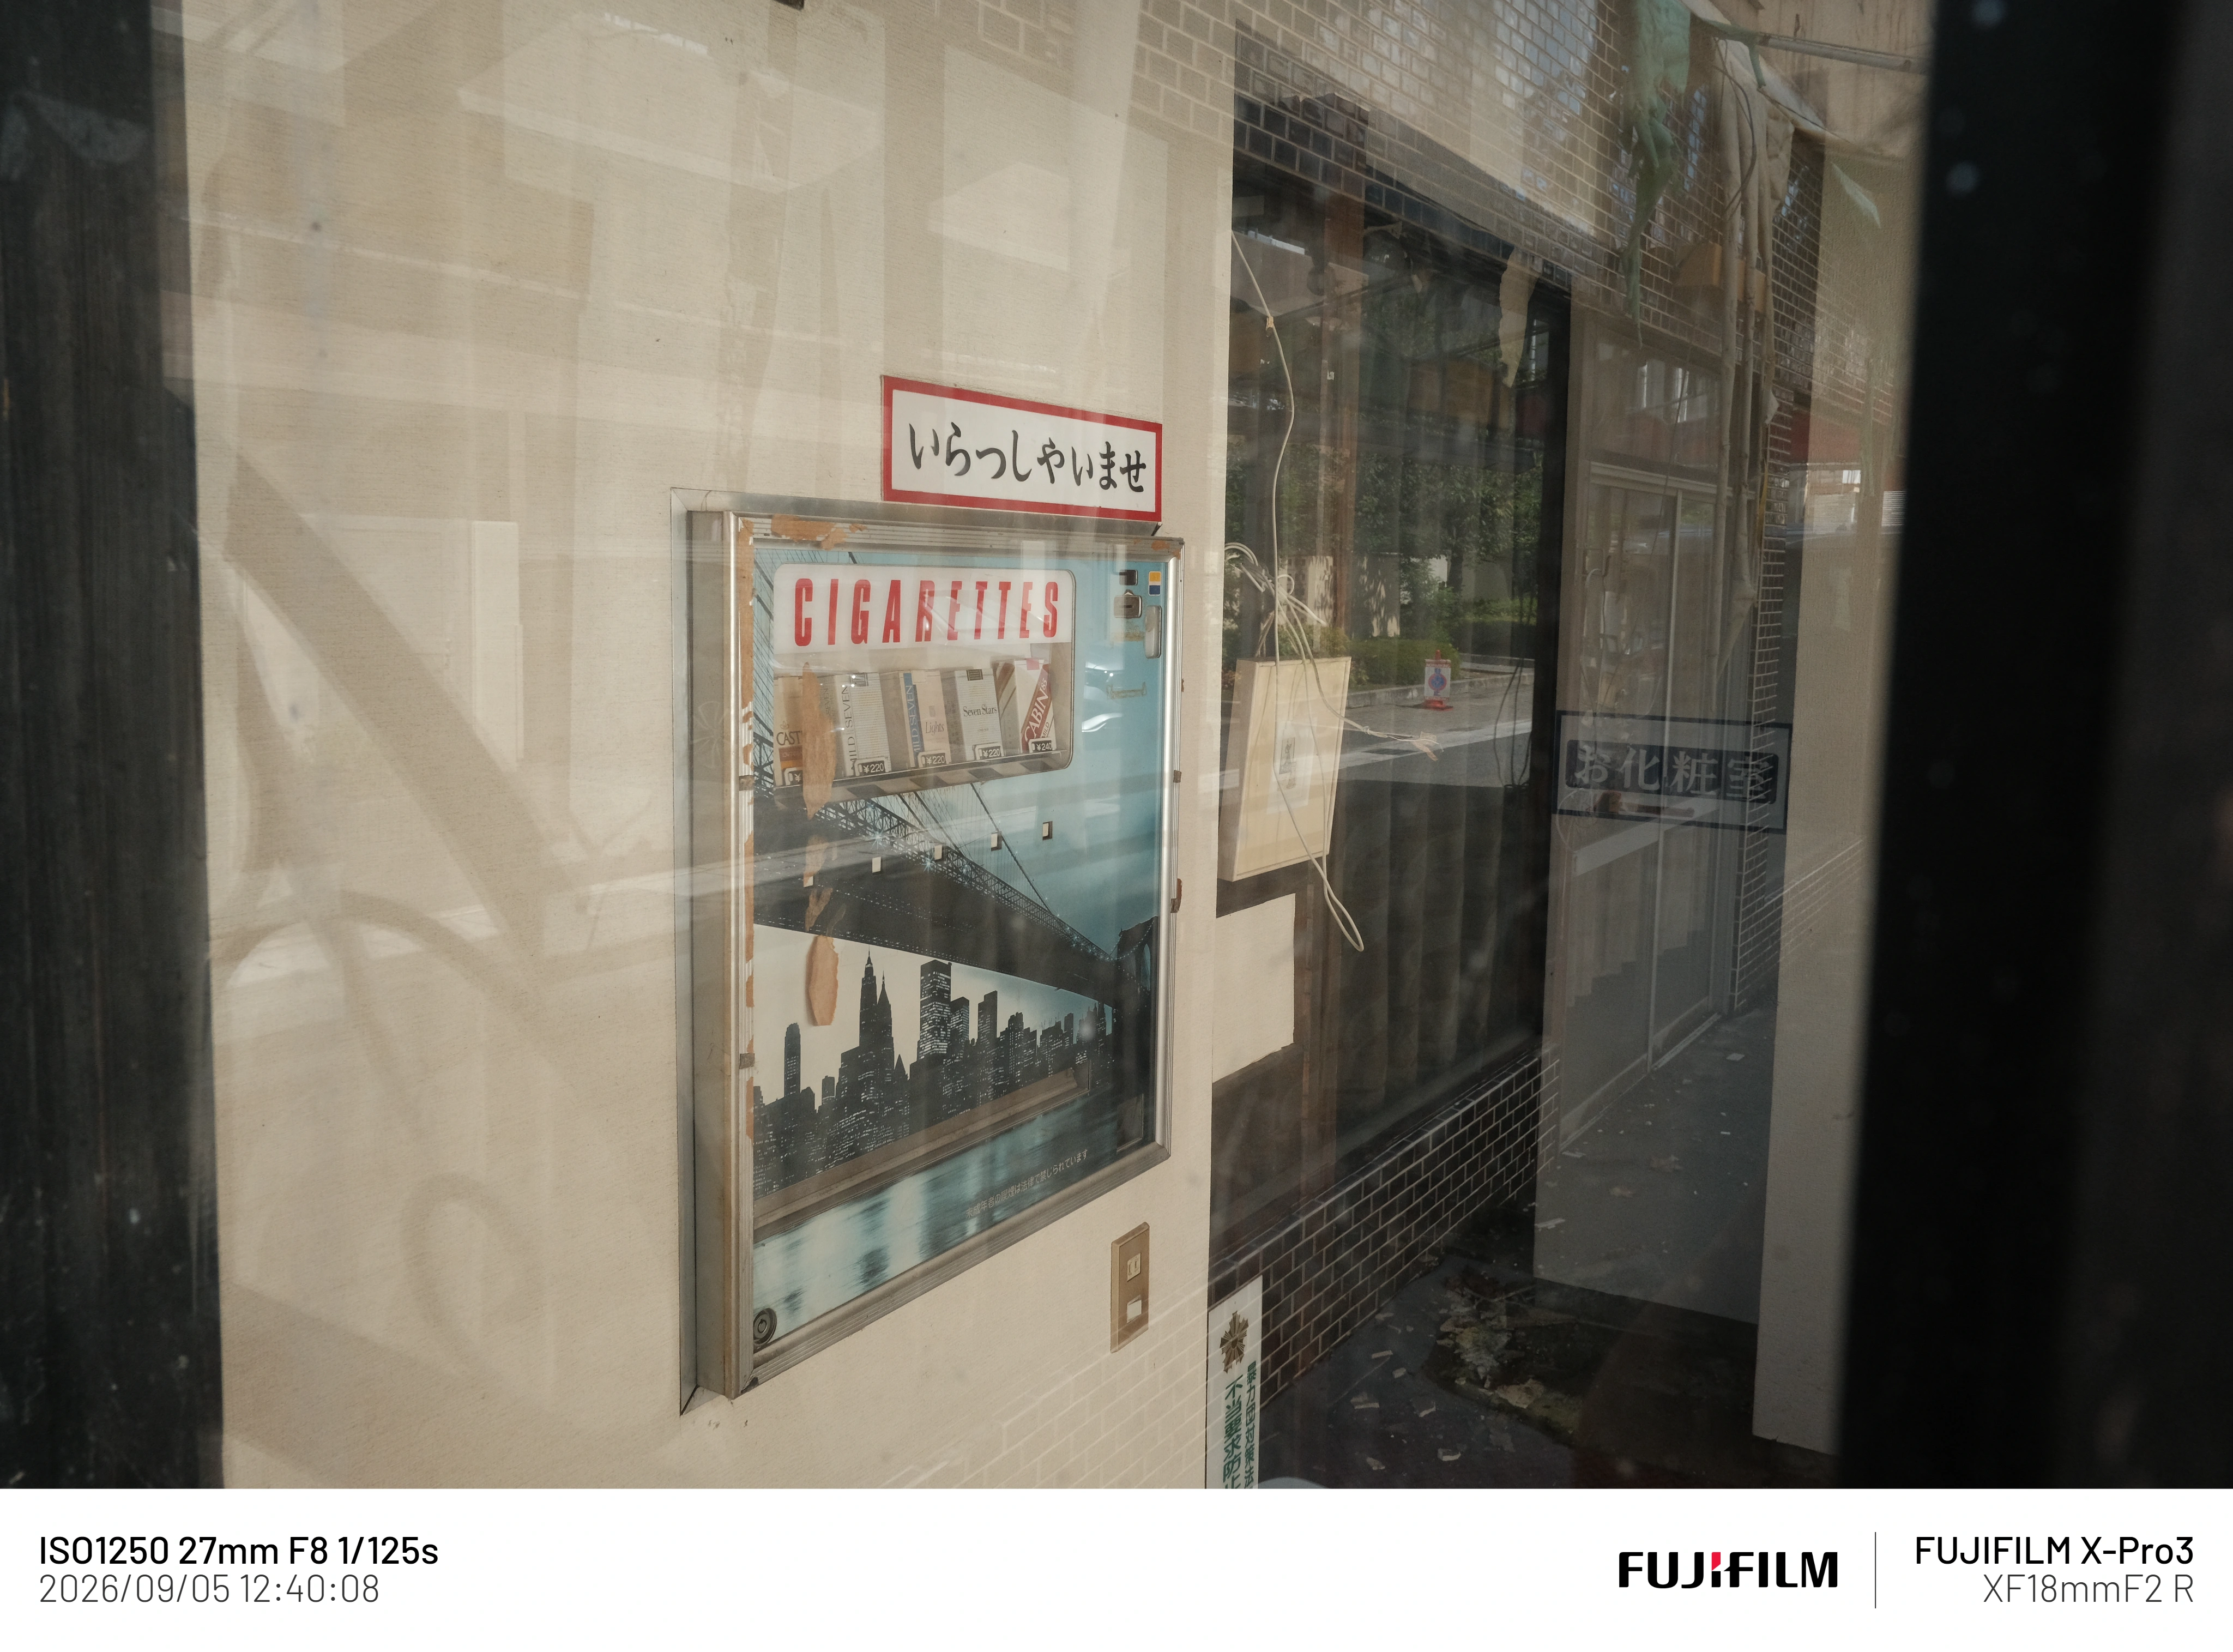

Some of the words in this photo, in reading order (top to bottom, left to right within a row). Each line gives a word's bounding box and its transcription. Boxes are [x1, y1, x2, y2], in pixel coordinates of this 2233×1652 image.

[794, 578, 1058, 647] CIGARETTES
[841, 685, 854, 728] SEVEN
[906, 685, 916, 726] SEVEN
[963, 706, 981, 717] Seven
[981, 704, 998, 715] Stars
[925, 721, 945, 736] Lights
[776, 731, 803, 746] CAST
[983, 749, 1000, 758] ¥220
[1036, 743, 1052, 751] ¥240
[927, 755, 945, 765] ¥220
[863, 763, 884, 774] ¥220
[1573, 743, 1770, 800] お化粧室
[965, 1149, 1088, 1219] 未成年者の喫煙は法律で禁じられています
[1245, 1360, 1257, 1489] 暴力団対策法
